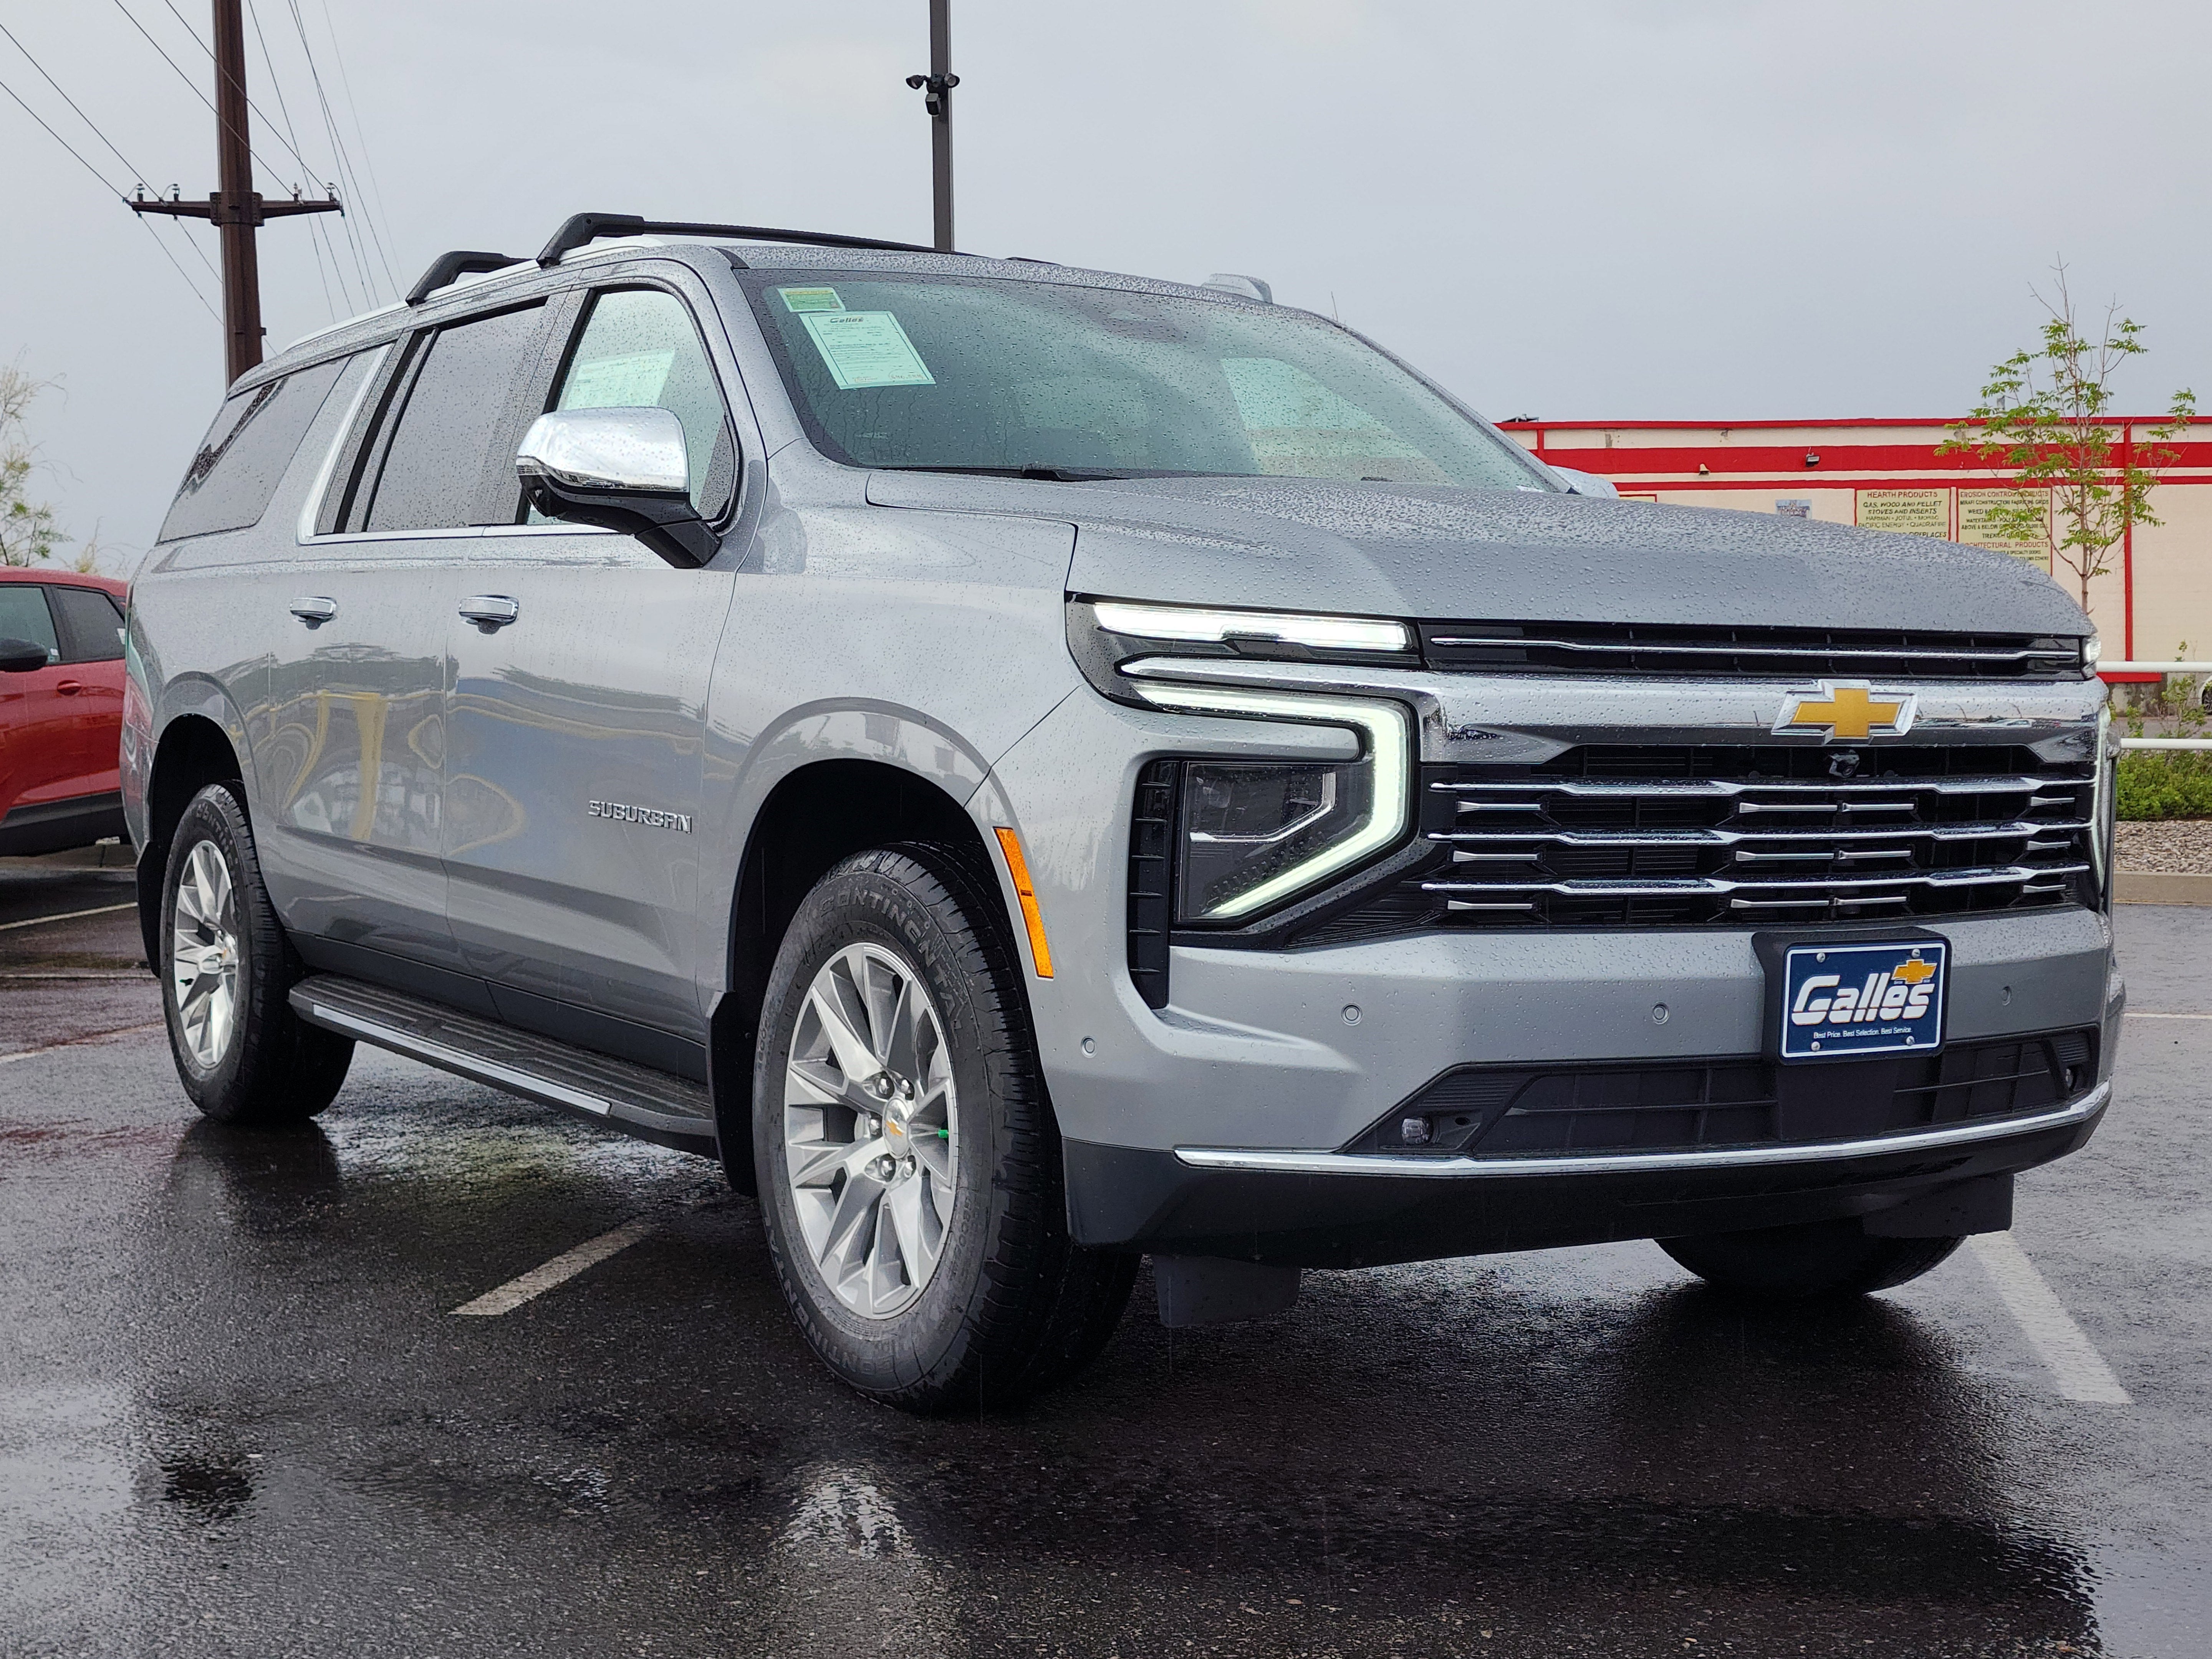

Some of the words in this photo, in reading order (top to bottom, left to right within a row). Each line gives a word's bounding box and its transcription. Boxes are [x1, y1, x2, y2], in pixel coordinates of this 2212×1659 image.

[588, 800, 692, 834] SUBURBAN
[820, 888, 962, 1048] CONTINENTAL
[1791, 972, 1936, 1026] Galles
[1856, 1028, 1880, 1037] Selection.
